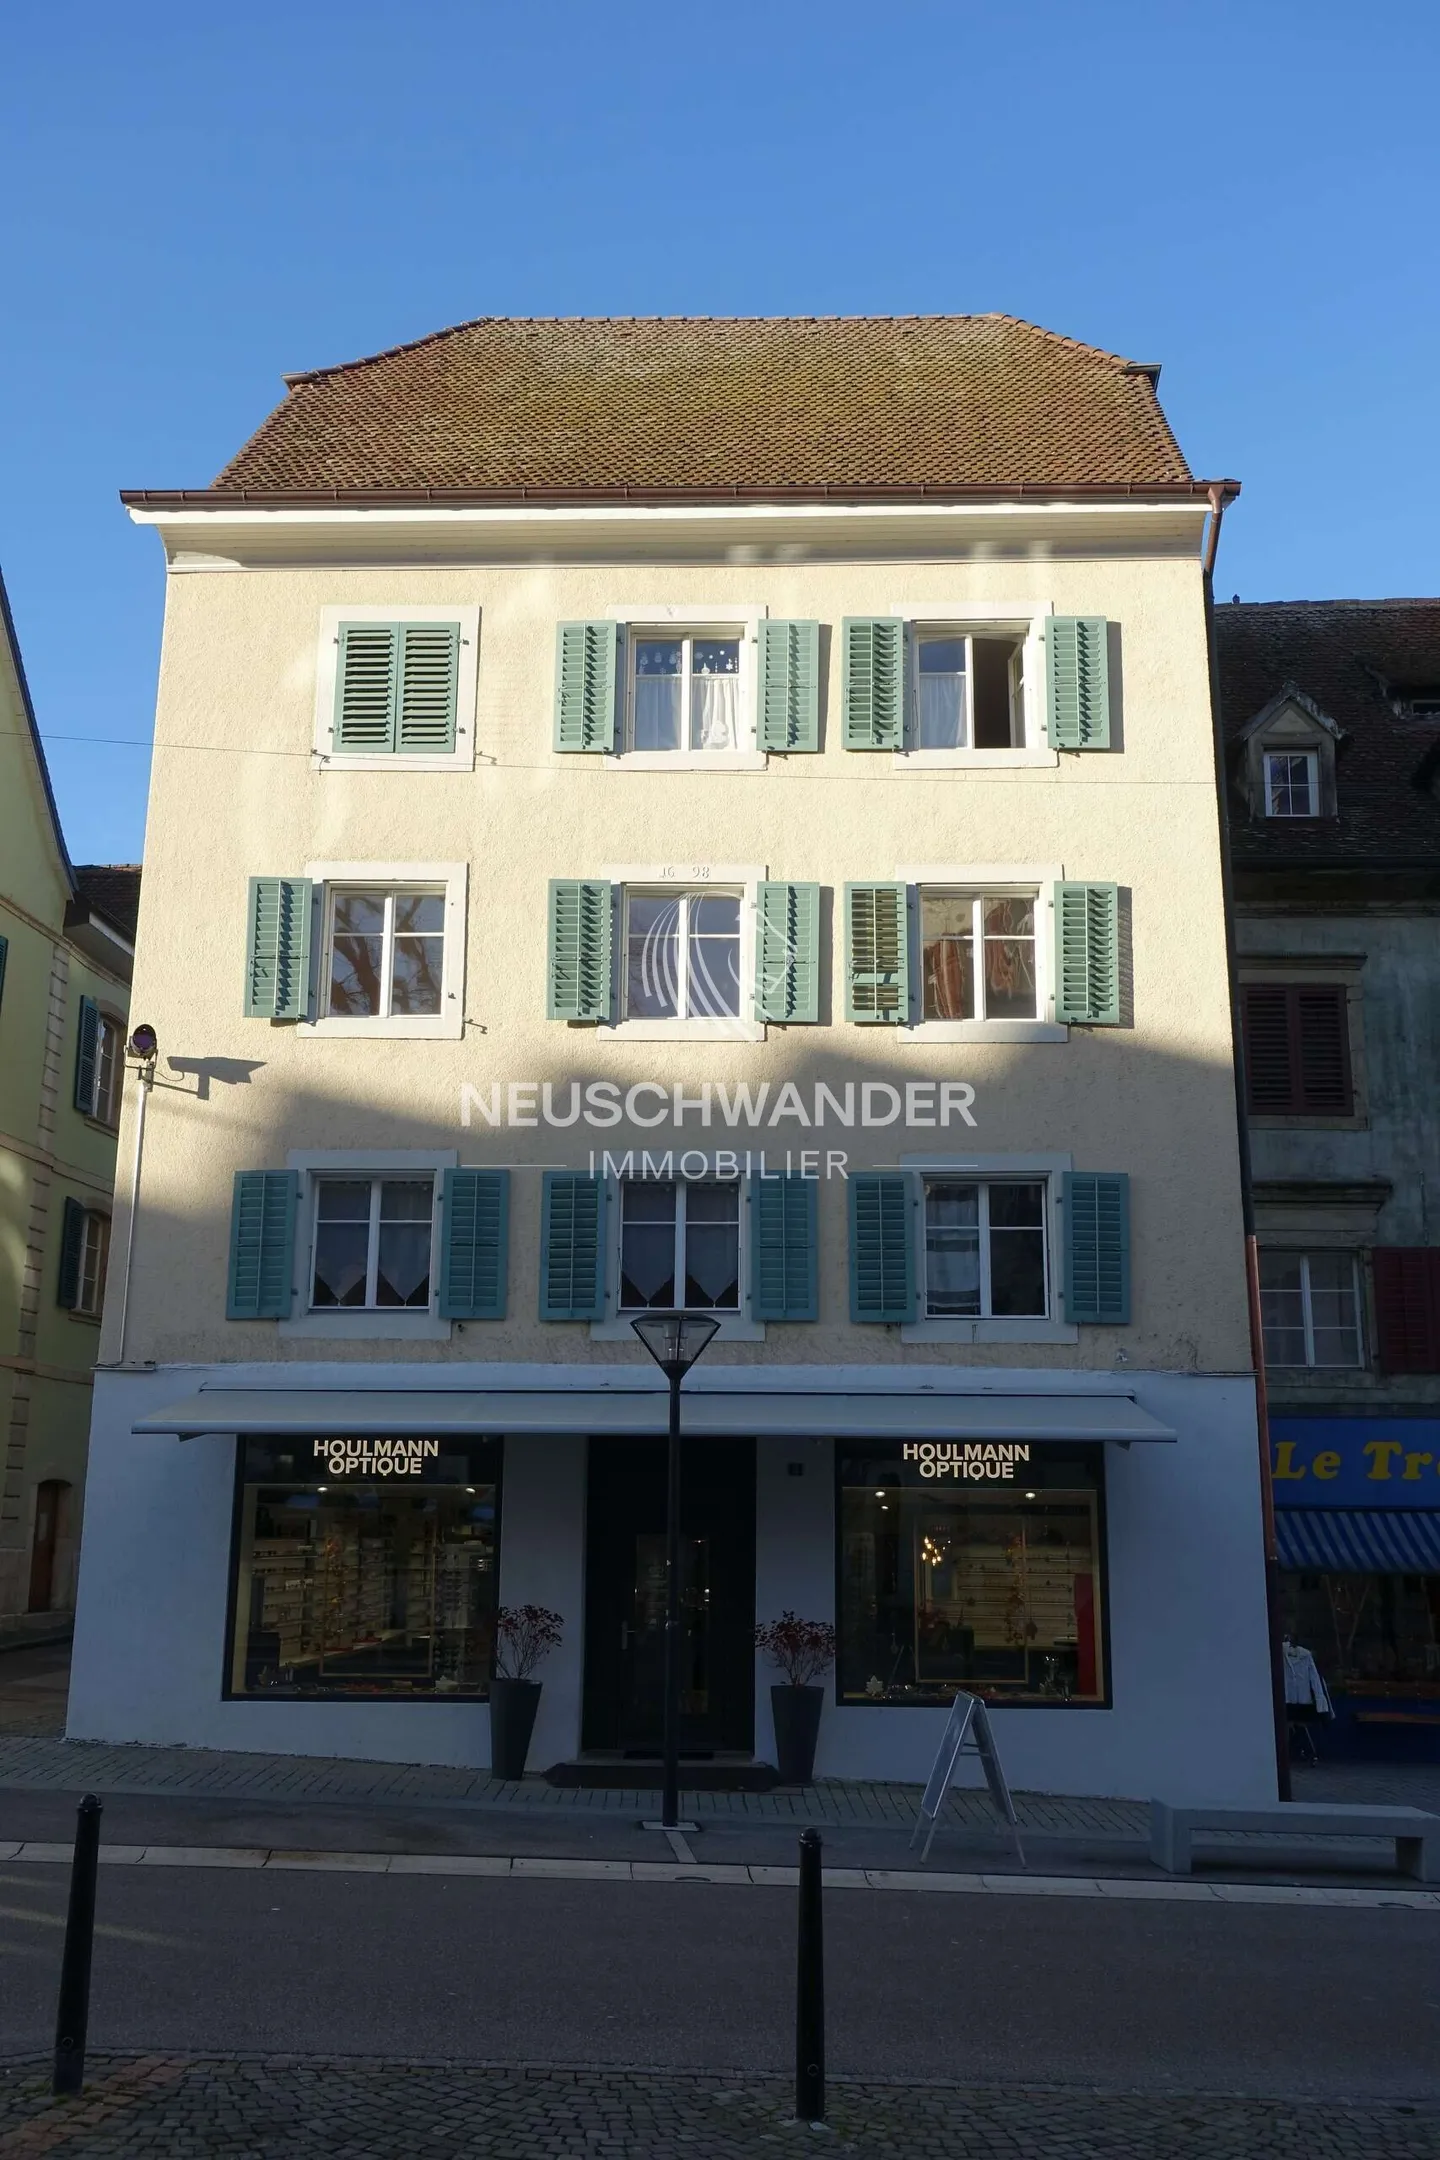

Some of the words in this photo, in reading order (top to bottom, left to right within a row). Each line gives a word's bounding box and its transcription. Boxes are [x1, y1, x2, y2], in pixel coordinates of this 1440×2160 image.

[313, 1440, 439, 1457] HOULMANN
[903, 1443, 1030, 1462] HOULMANN
[328, 1457, 422, 1476] OPTIQUE
[1271, 1441, 1341, 1480] Le
[1362, 1440, 1440, 1480] Tr
[919, 1461, 1014, 1480] OPTIQUE
